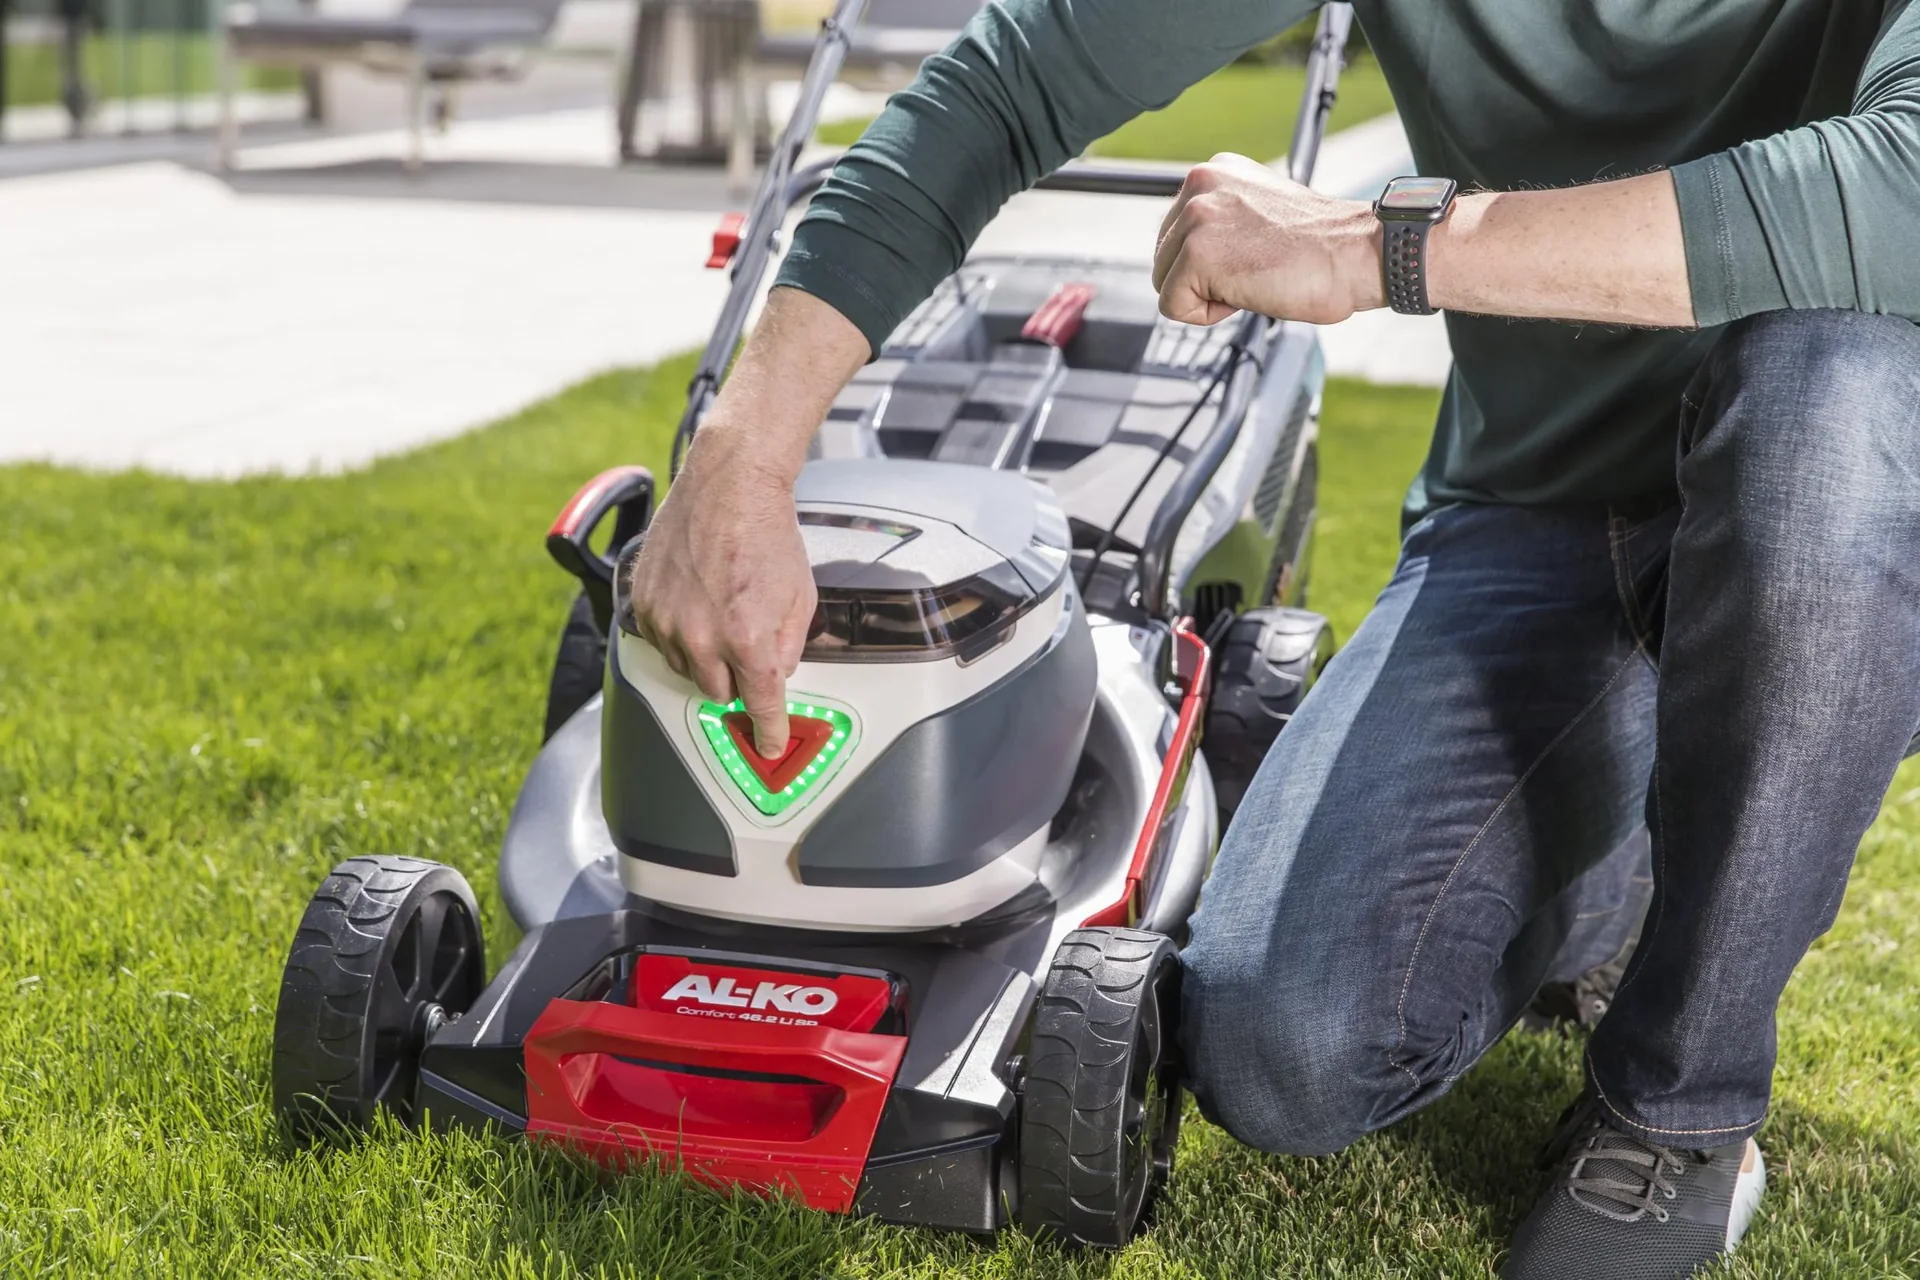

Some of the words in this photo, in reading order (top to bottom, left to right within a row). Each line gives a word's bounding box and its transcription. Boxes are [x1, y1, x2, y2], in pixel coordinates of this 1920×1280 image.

[661, 974, 838, 1016] AL-KO
[676, 1006, 736, 1019] Comfort
[738, 1013, 778, 1024] 46.2
